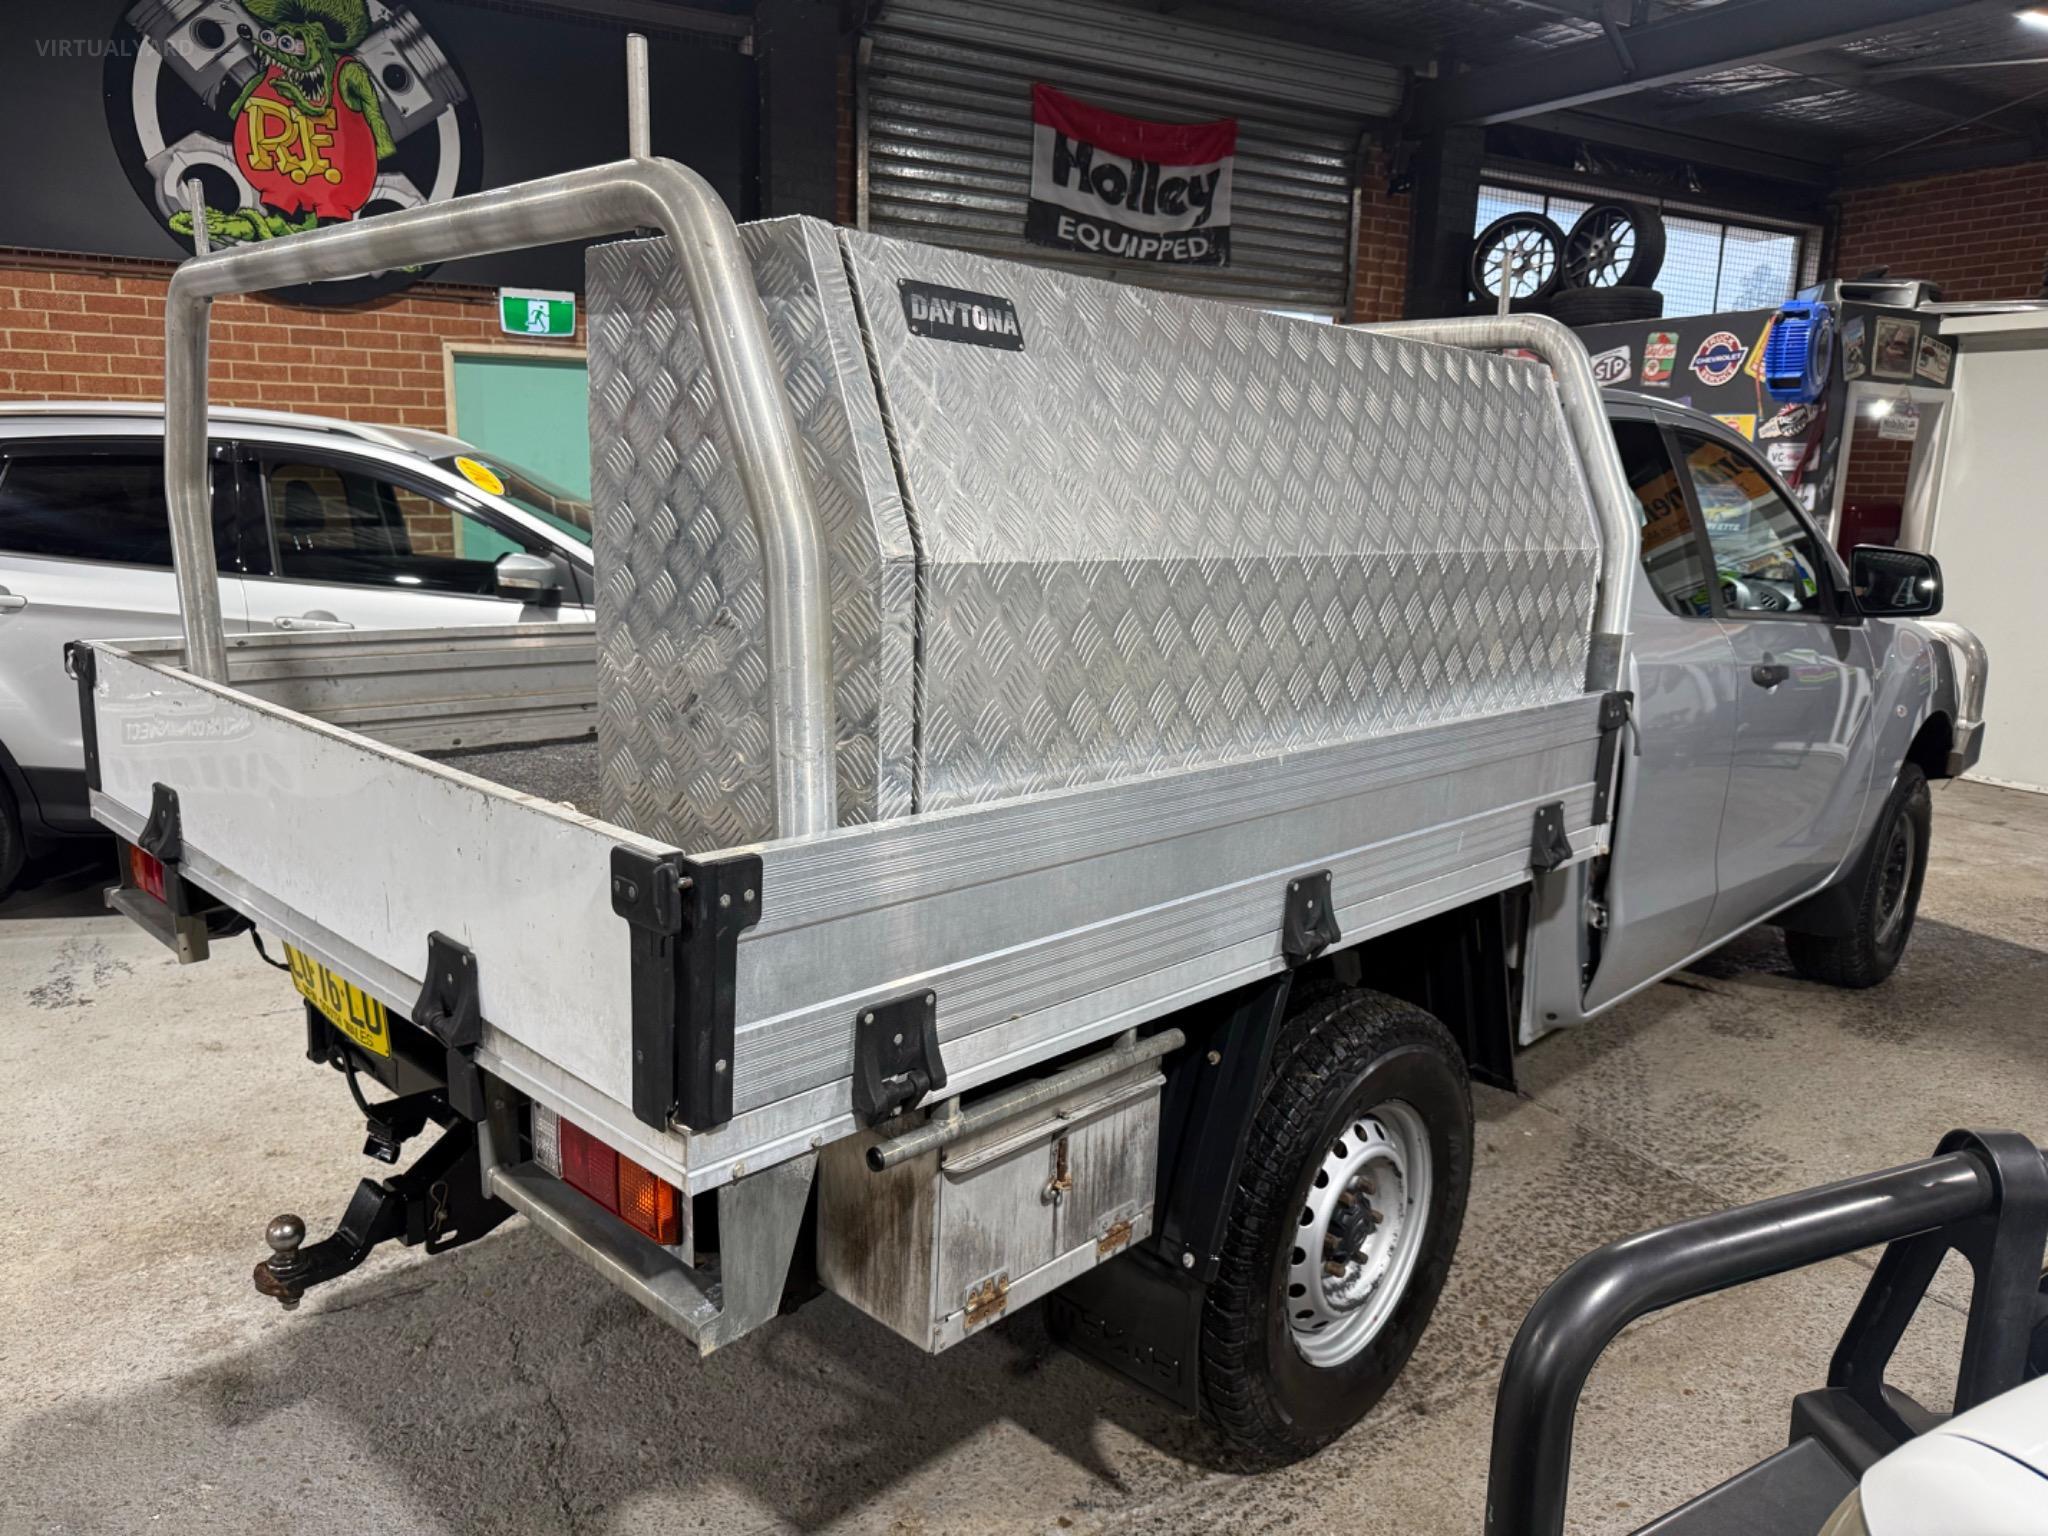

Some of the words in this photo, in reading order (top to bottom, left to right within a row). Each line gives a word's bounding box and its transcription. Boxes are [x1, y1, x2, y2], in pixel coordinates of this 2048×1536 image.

[1052, 131, 1221, 226] Holley
[1057, 215, 1209, 261] EQUIPPED
[910, 293, 1019, 336] DAYTONA
[1594, 357, 1625, 380] STP
[1695, 351, 1743, 365] CHEVROLET
[1771, 452, 1785, 463] VC
